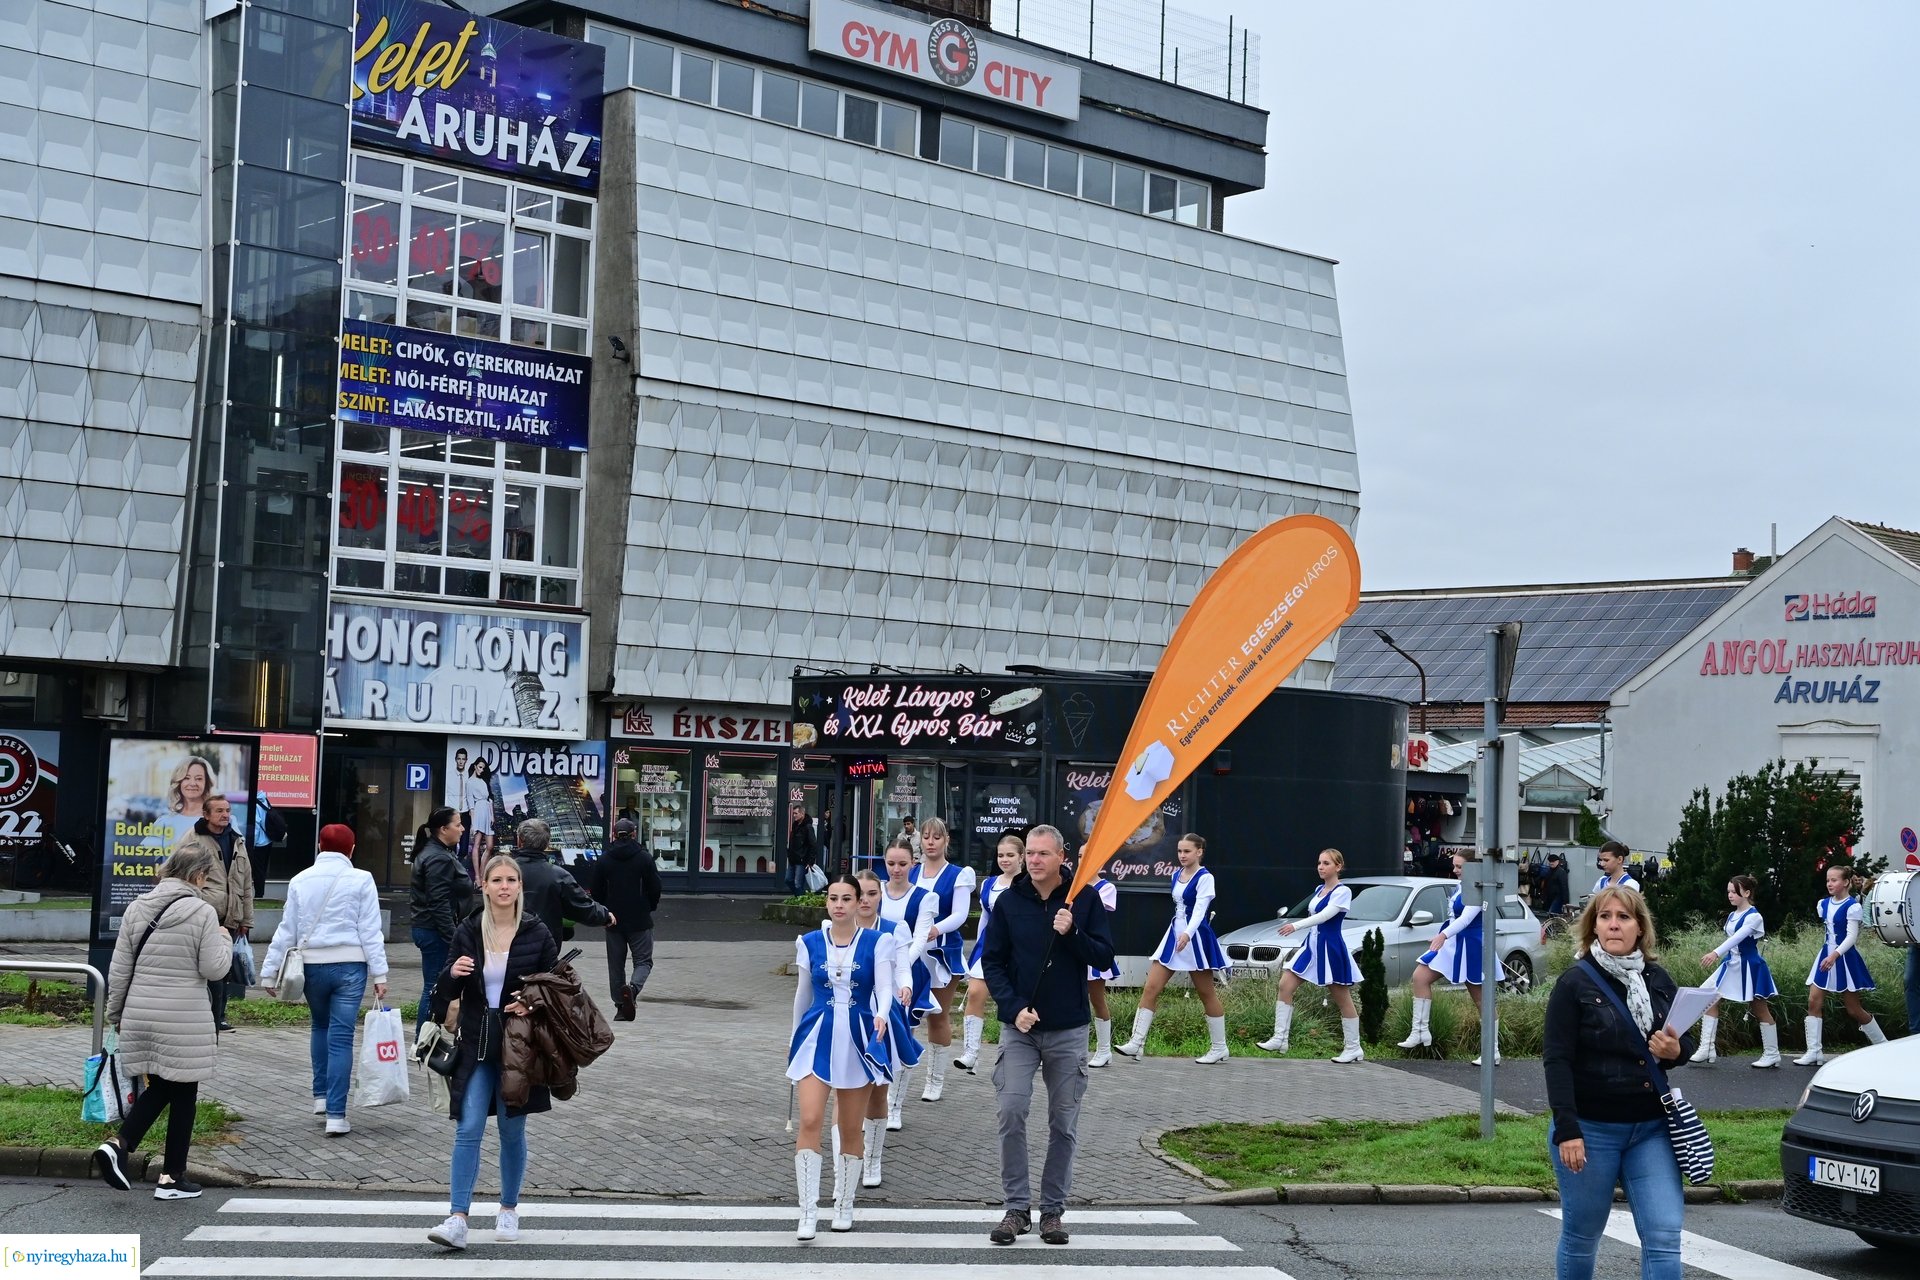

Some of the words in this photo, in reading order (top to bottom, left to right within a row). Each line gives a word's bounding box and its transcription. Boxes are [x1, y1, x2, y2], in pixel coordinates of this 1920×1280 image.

[930, 22, 951, 58] FITNESS
[961, 30, 976, 69] MUSIC
[841, 21, 919, 73] GYM
[983, 61, 1052, 107] CITY
[396, 86, 594, 178] ÁRUHÁZ
[396, 340, 449, 366] CIPŐK,
[453, 350, 583, 385] GYEREKRUHÁZAT
[395, 369, 472, 397] NŐI-FÉRFI
[477, 383, 547, 408] RUHÁZAT
[338, 391, 390, 414] SZINT:
[393, 399, 500, 431] LAKÁSTEXTIL,
[505, 413, 550, 436] JÁTÉK
[1812, 590, 1877, 615] Háda
[328, 613, 439, 667] HONG
[453, 624, 568, 676] KONG
[1165, 656, 1242, 737] RICHTER
[1240, 545, 1338, 656] EGÉSZSÉGVÁROS
[1700, 639, 1793, 676] ANGOL
[324, 667, 560, 729] ÁRUHÁZ
[843, 683, 891, 709] Kelet
[894, 684, 975, 717] Lángos
[1179, 714, 1209, 748] Egészség
[1236, 659, 1258, 684] milliók
[1261, 619, 1294, 656] kórháznak
[1773, 674, 1881, 704] ÁRUHÁZ
[823, 714, 840, 736] és
[845, 714, 884, 739] XXL
[890, 713, 951, 746] Gyros
[957, 713, 1003, 739] Bár
[269, 753, 302, 762] RUHÁZAT
[481, 740, 600, 777] Divatáru
[849, 763, 885, 776] NYITVA
[410, 766, 426, 788] P
[1066, 771, 1111, 791] Kelet
[115, 822, 175, 839] Boldog
[975, 825, 998, 833] GYEREK
[980, 816, 1003, 825] PAPLAN
[1008, 816, 1028, 825] PÁRNA
[1111, 859, 1149, 881] Gyros
[1818, 1160, 1877, 1189] TCV-142
